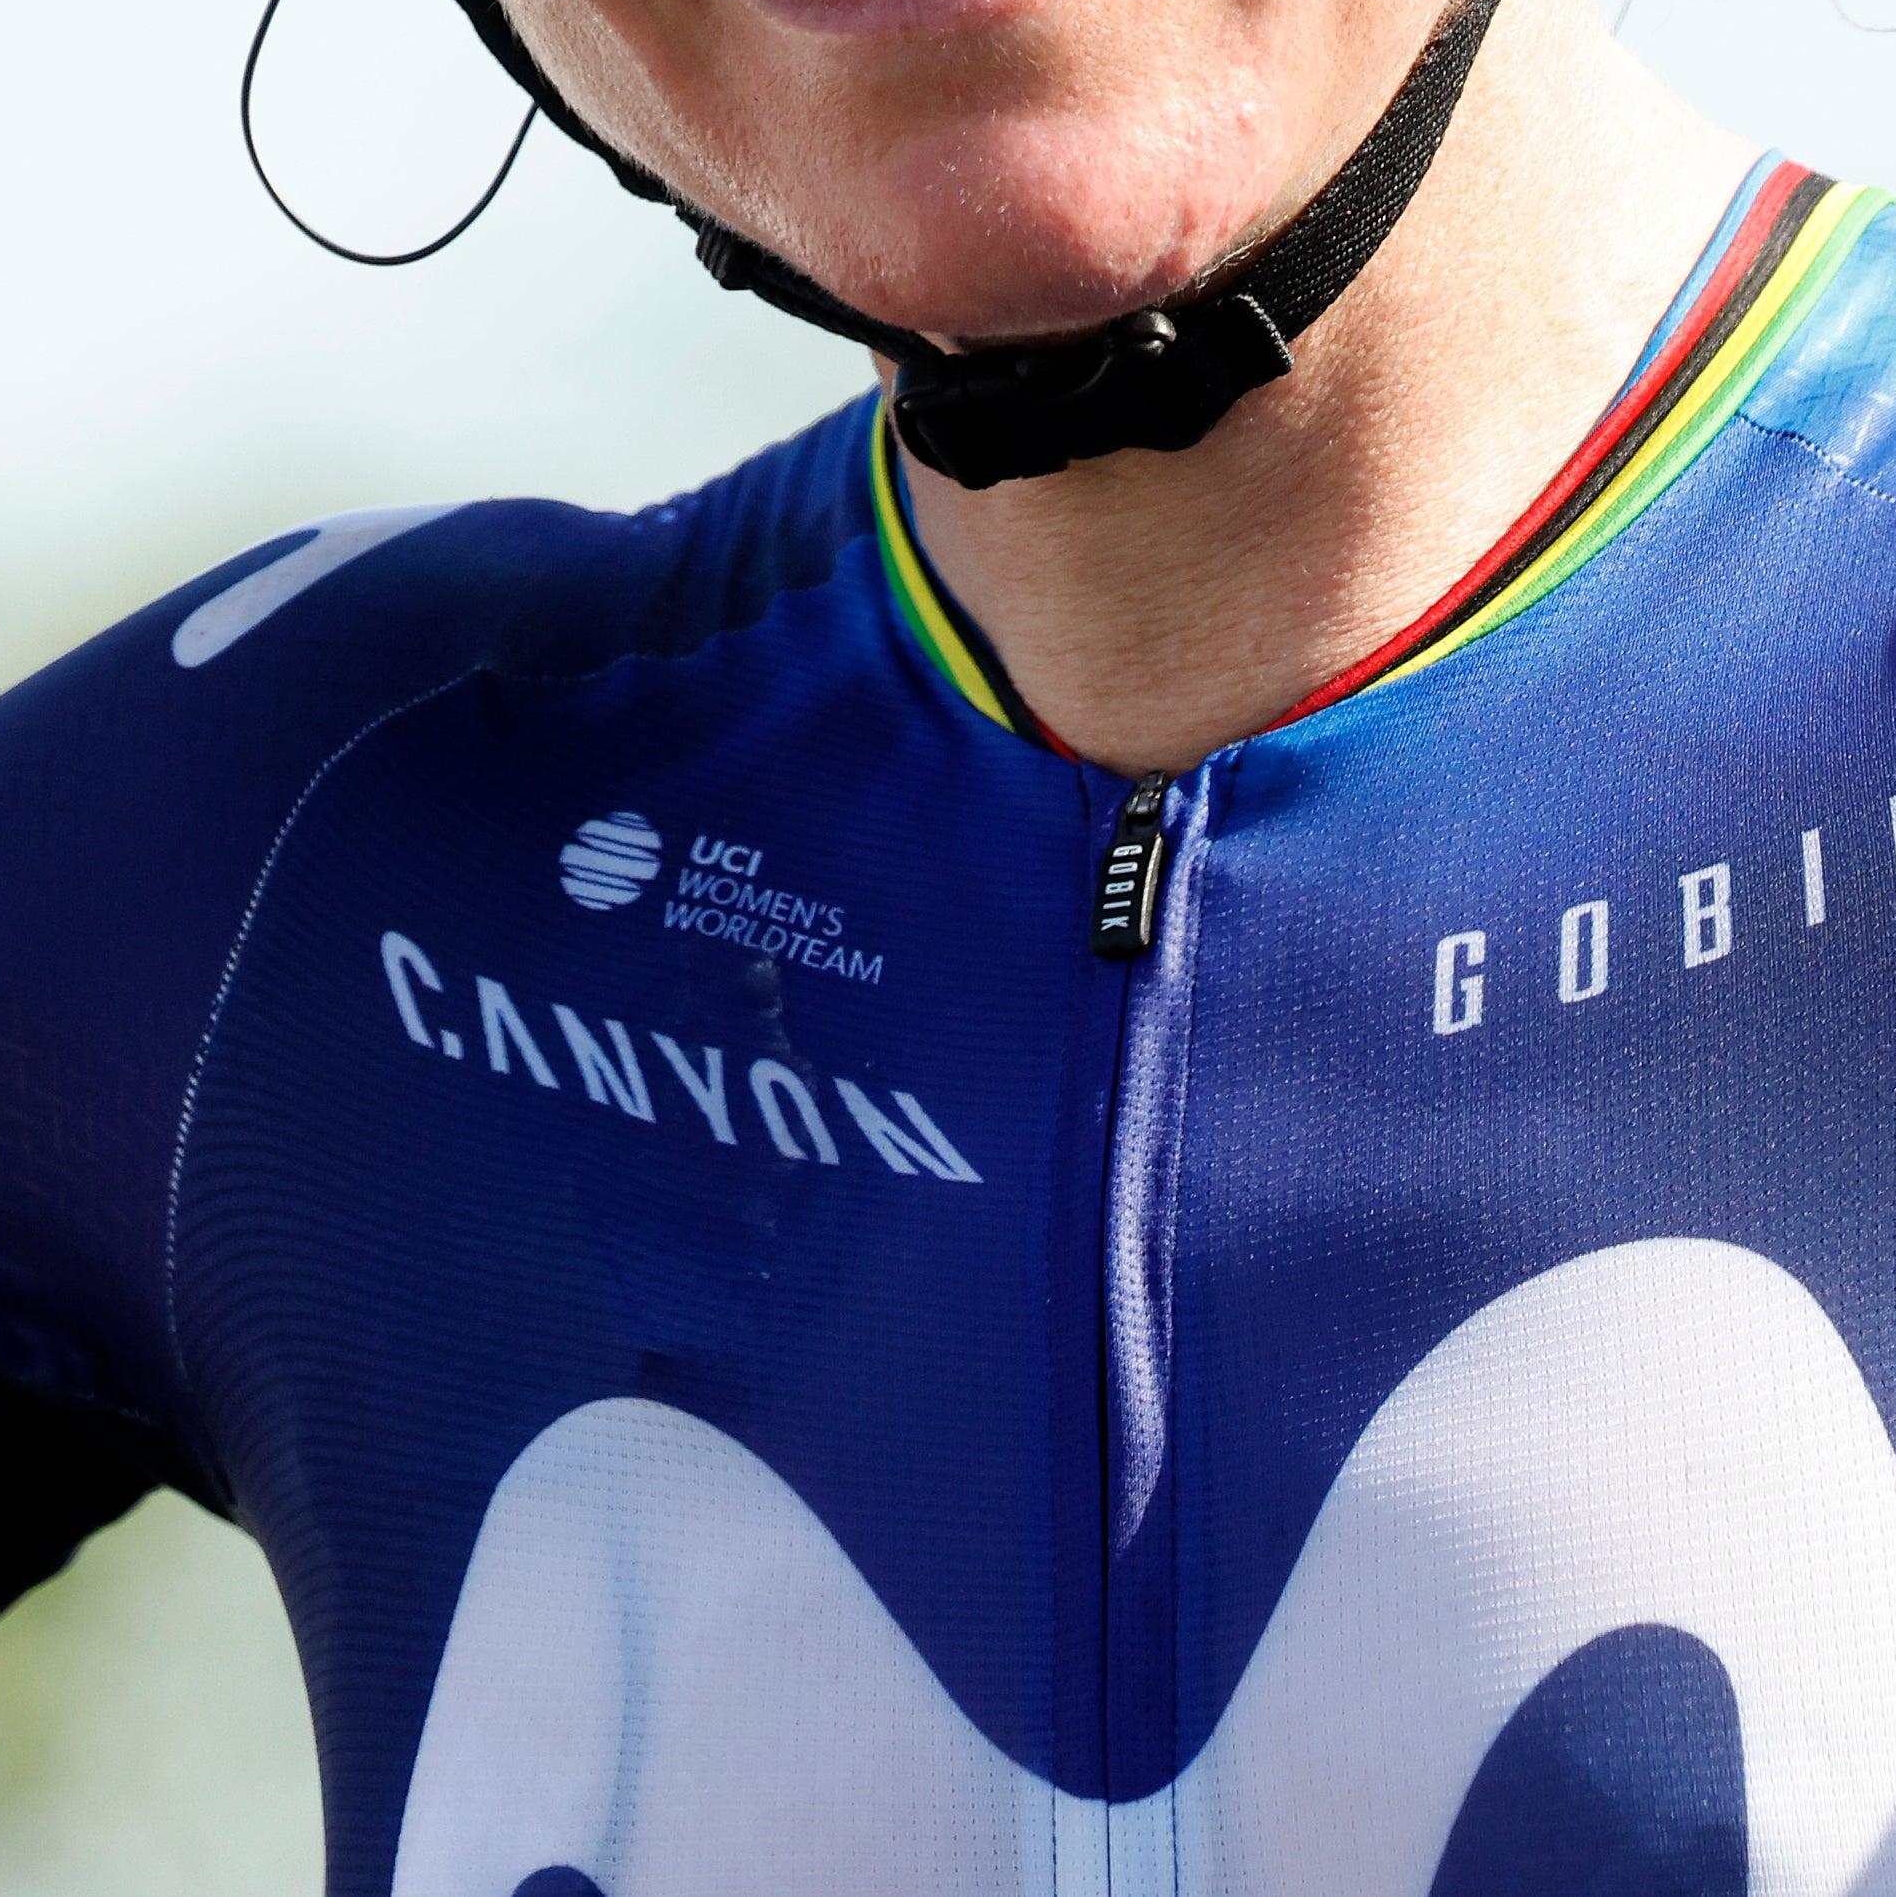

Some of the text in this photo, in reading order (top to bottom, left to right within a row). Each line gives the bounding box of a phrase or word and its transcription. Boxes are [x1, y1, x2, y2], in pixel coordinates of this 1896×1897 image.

[689, 835, 764, 877] UCI
[1100, 844, 1144, 932] GOBIK
[663, 900, 885, 985] WORLDTEAM
[676, 867, 846, 938] WOMEN'S
[380, 930, 985, 1184] CANYON
